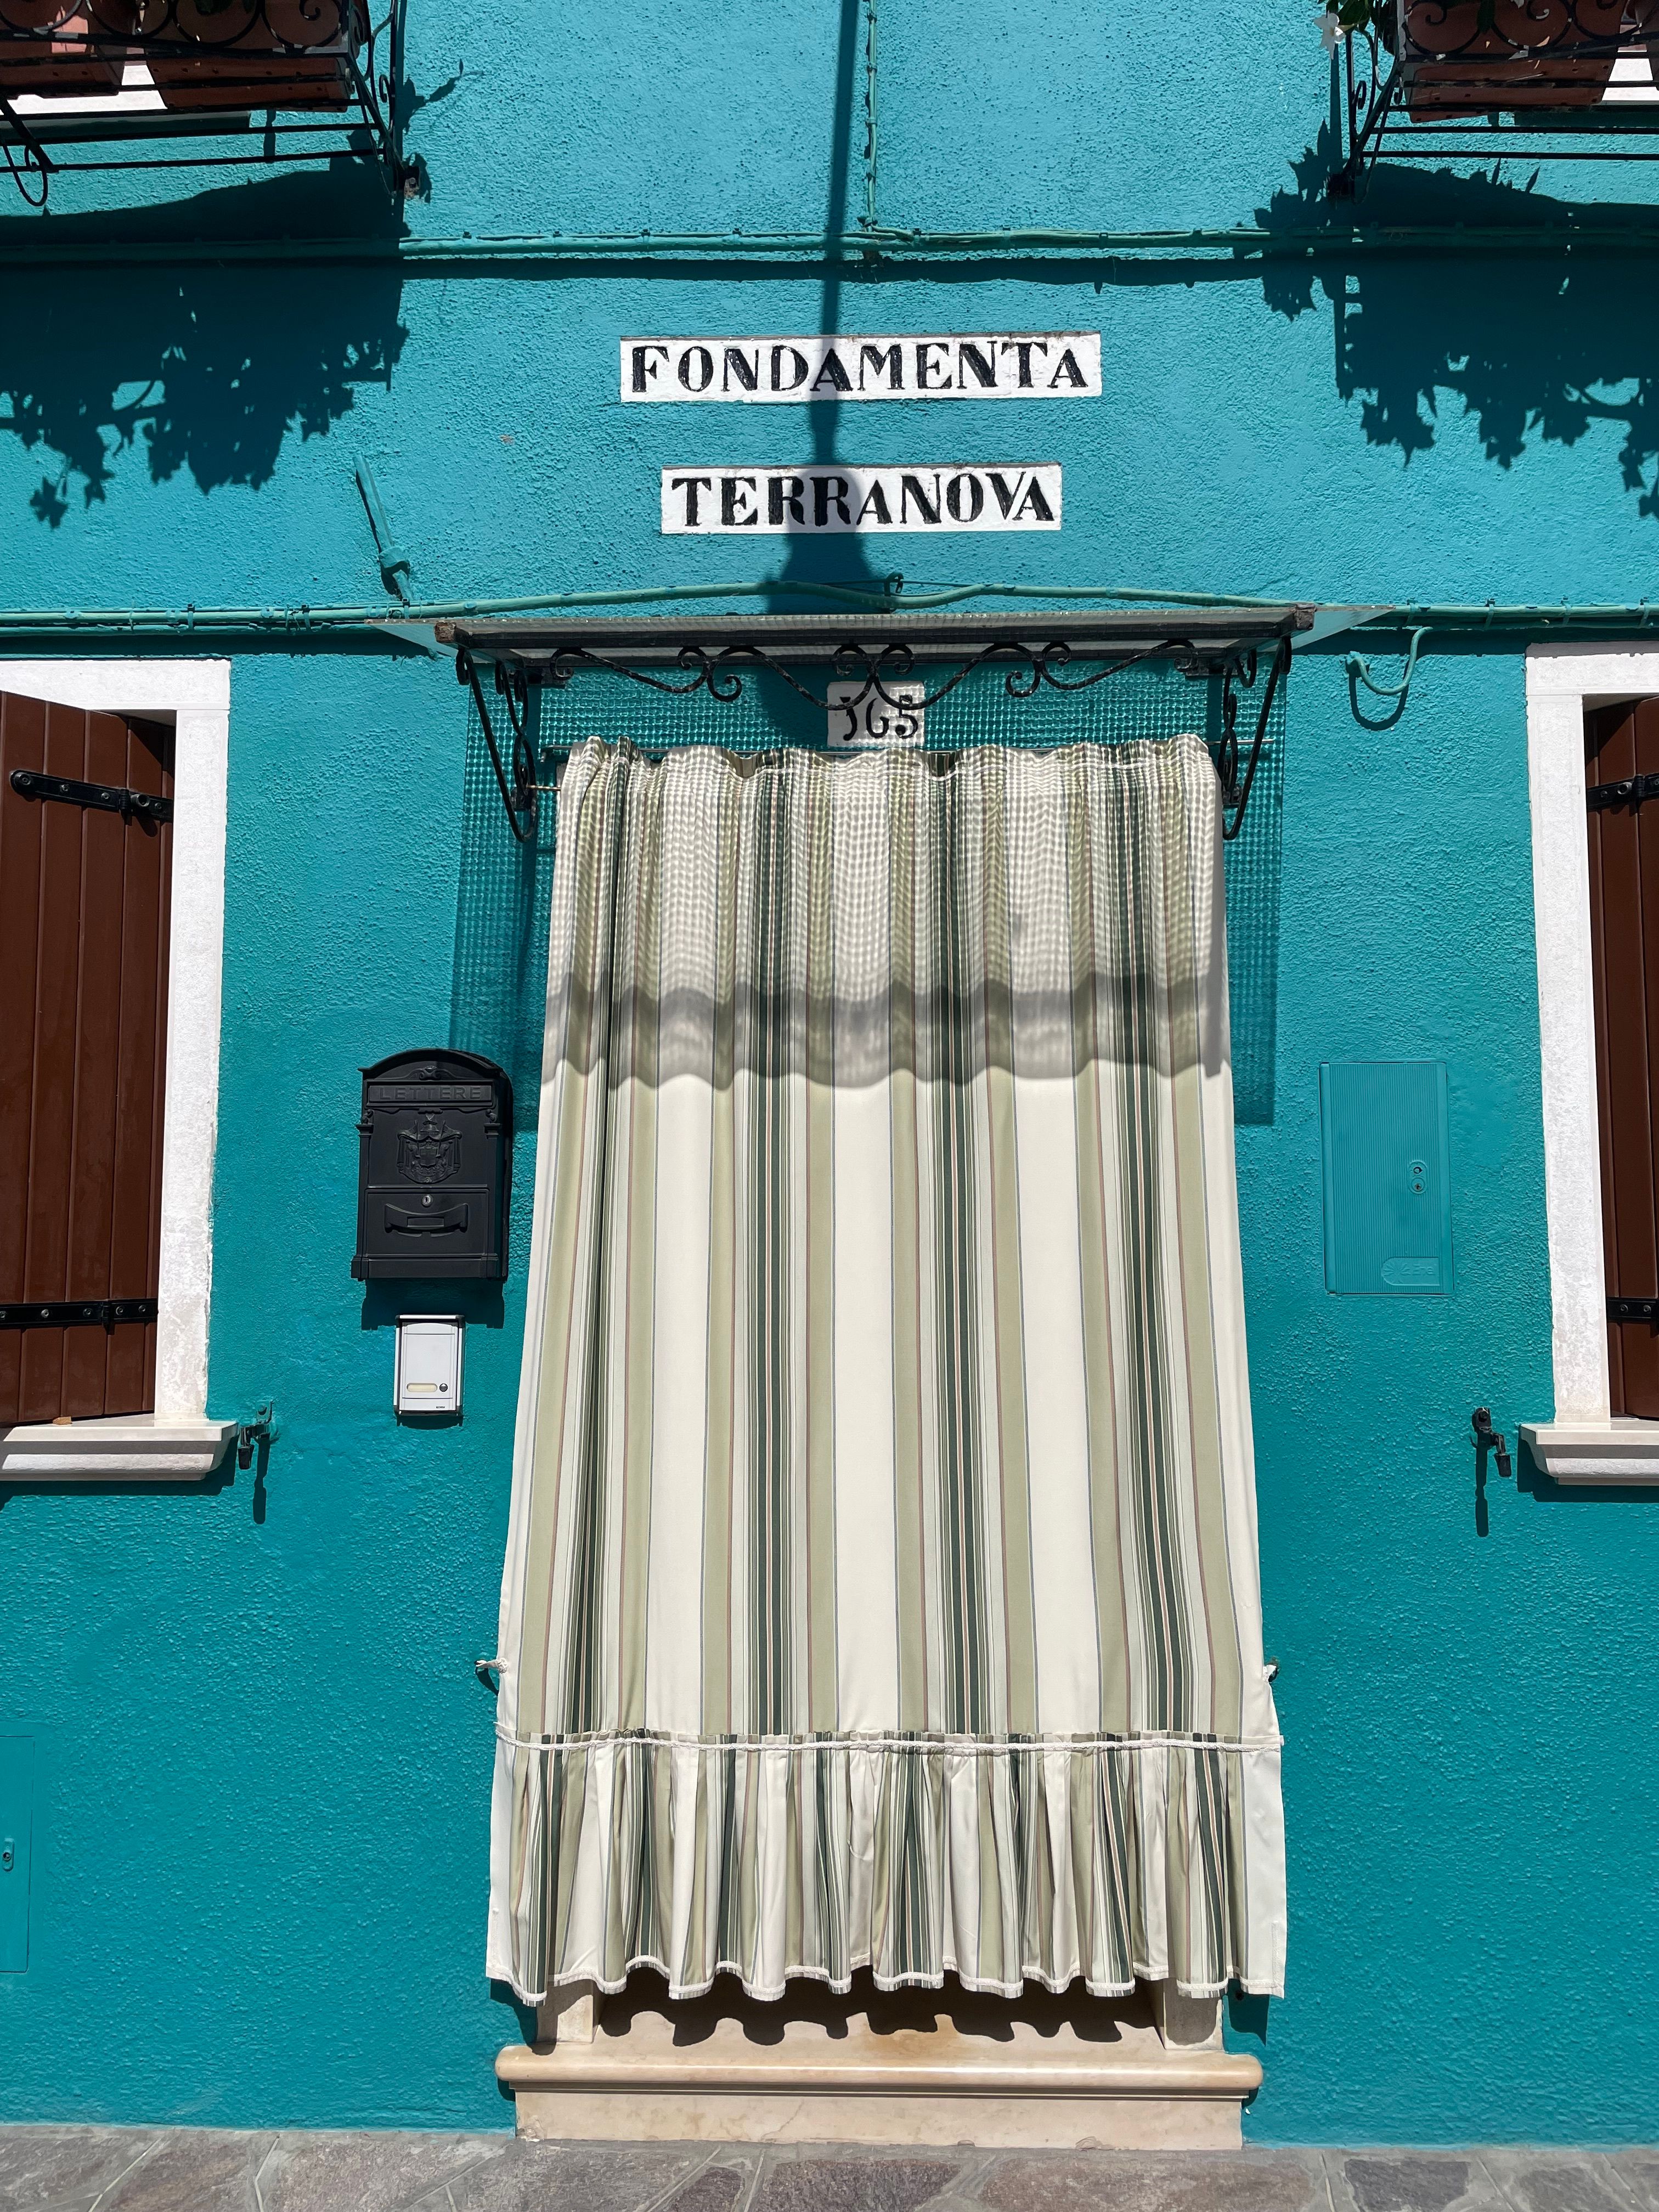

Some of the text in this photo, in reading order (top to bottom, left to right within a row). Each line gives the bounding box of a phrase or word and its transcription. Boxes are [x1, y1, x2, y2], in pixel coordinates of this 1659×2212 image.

[632, 341, 1088, 393] FONDAMENTA
[672, 472, 1054, 527] TERRANOVA
[839, 695, 918, 741] 365
[379, 1087, 481, 1100] LETTERE
